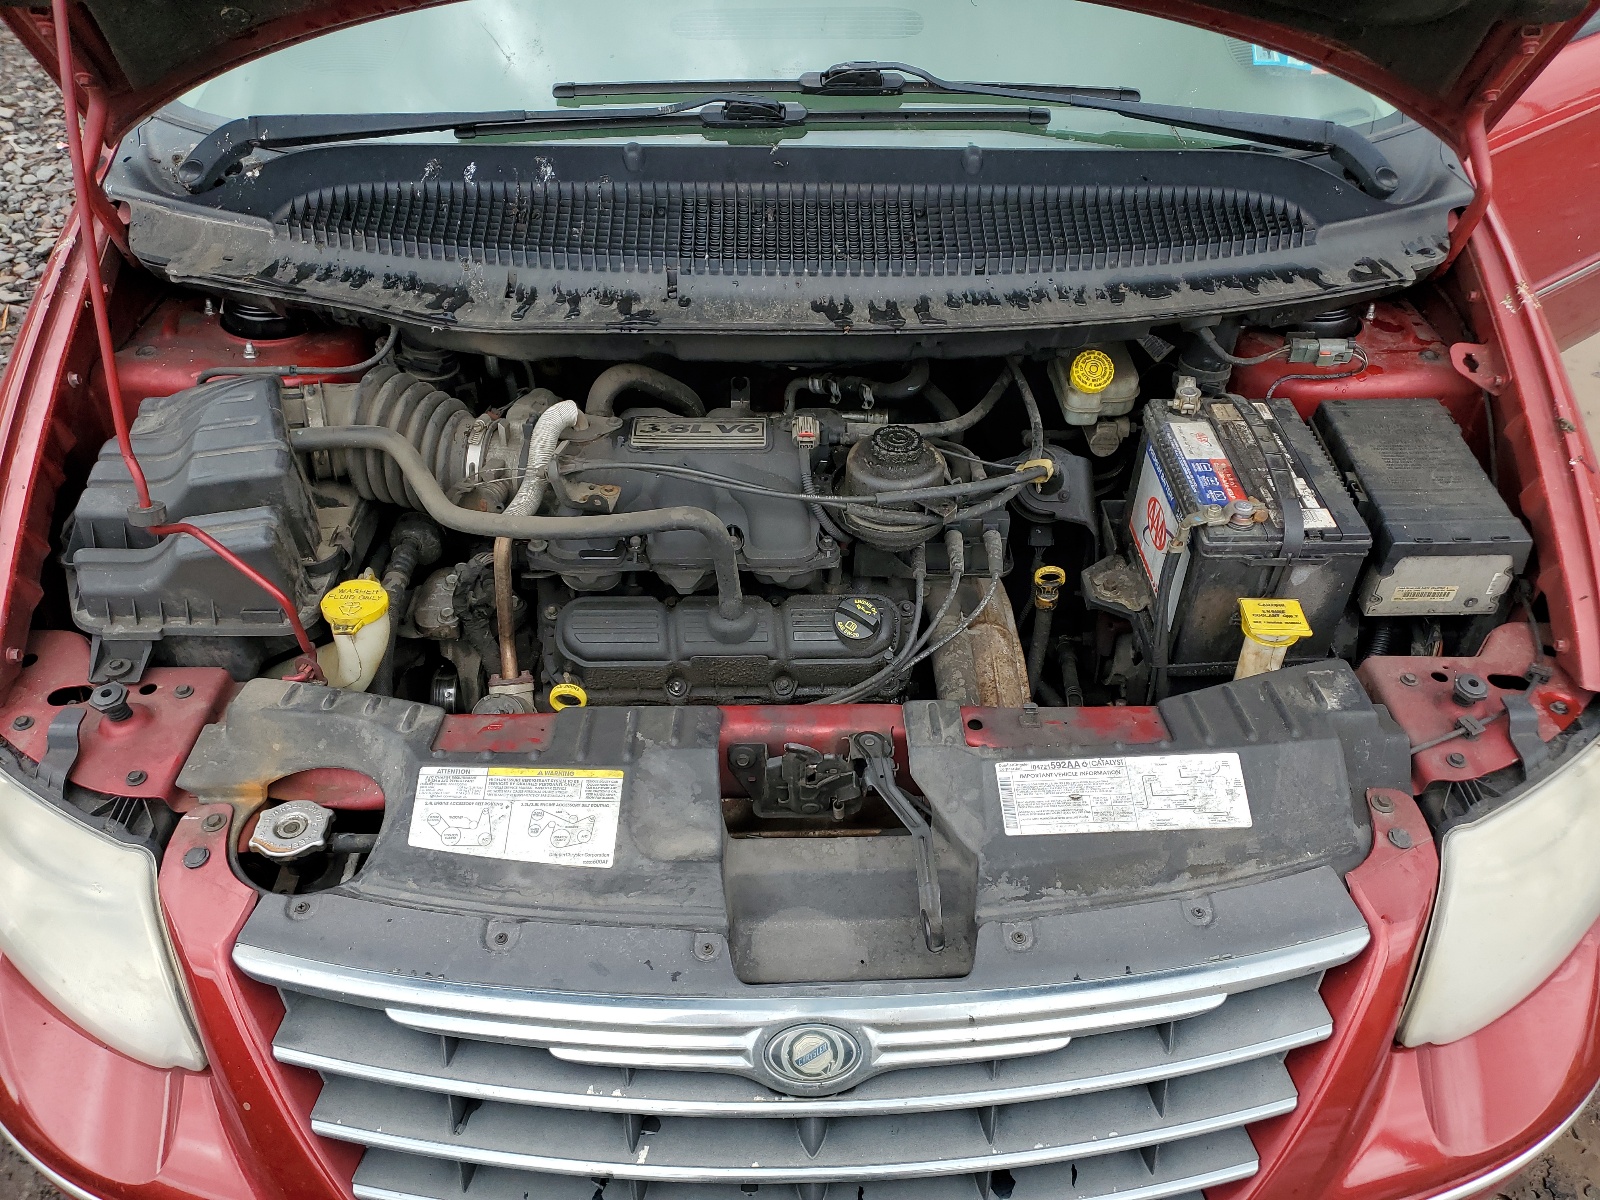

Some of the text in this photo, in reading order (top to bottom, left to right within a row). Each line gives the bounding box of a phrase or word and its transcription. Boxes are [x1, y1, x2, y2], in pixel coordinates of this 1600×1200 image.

[640, 423, 759, 434] 3.8L V6
[1091, 759, 1124, 767] CATALYST
[1019, 771, 1053, 779] IMPORTANT
[1079, 769, 1121, 777] INFORMATION
[798, 1042, 828, 1066] CHRYSLER
